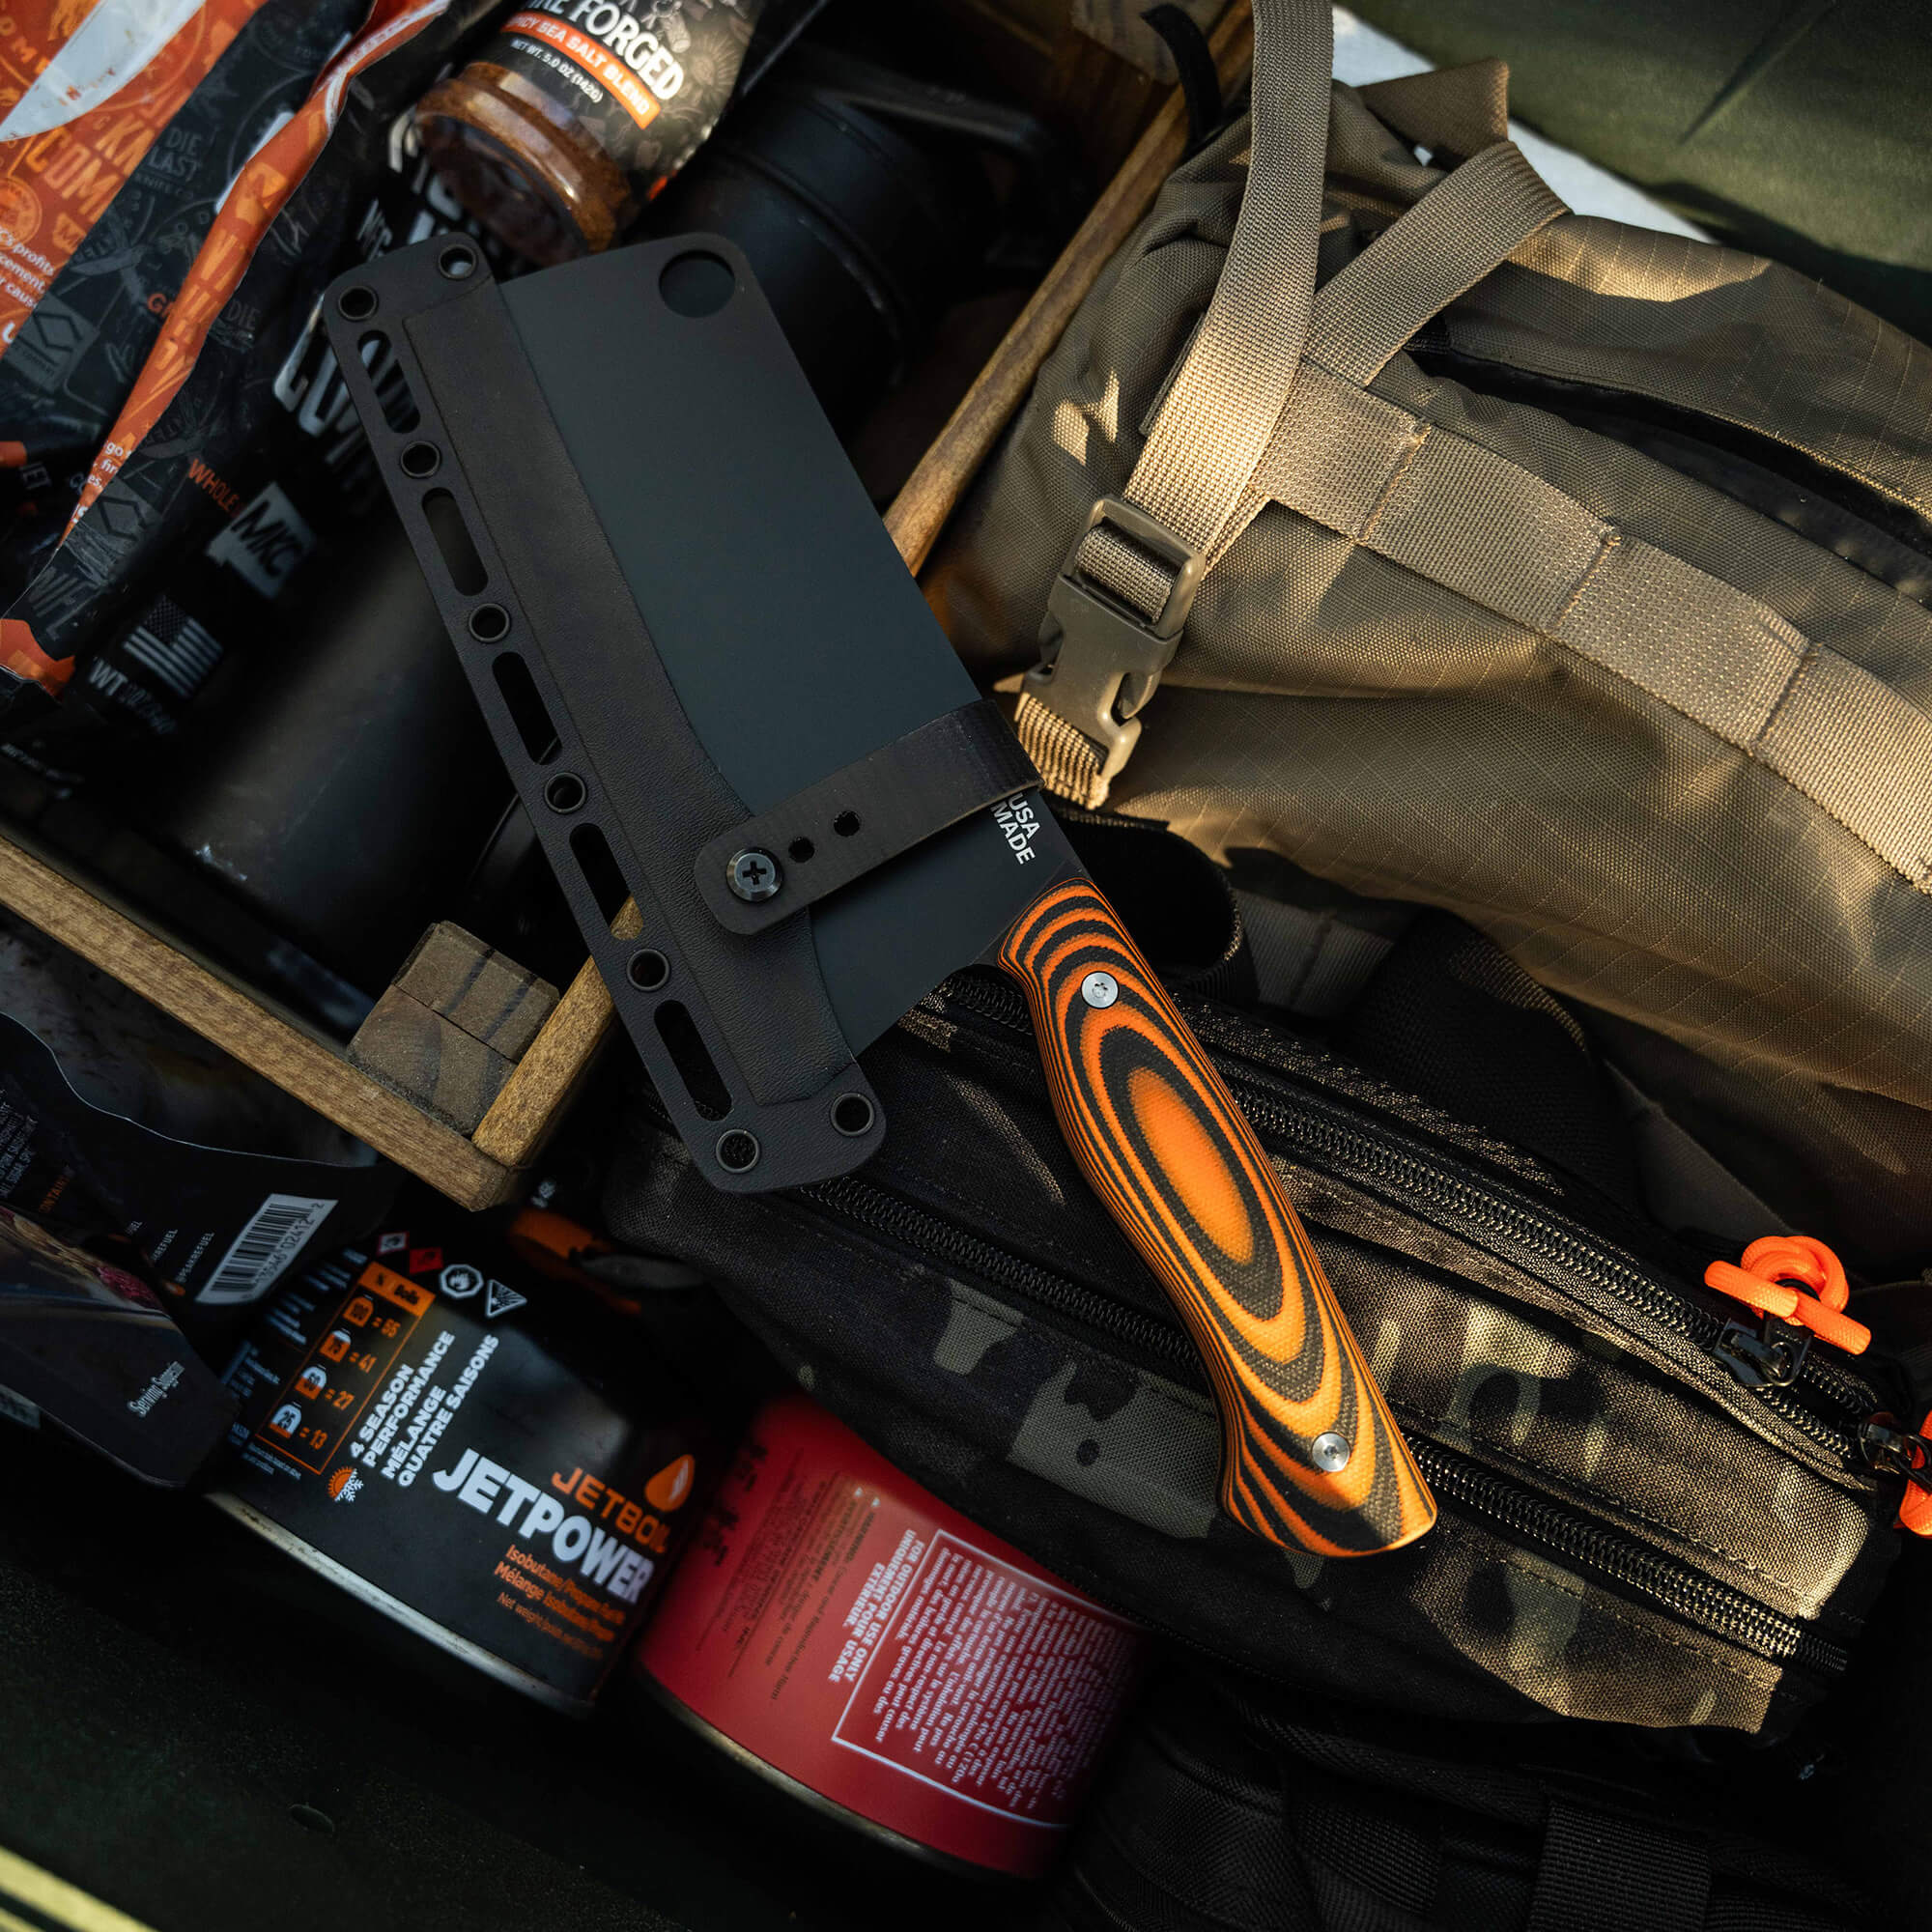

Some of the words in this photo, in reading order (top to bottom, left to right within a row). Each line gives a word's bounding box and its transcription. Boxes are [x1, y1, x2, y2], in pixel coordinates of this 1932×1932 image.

[542, 52, 560, 69] 5.0
[559, 61, 574, 77] OZ
[569, 0, 684, 99] FORGED
[537, 21, 567, 42] SEA
[566, 36, 607, 68] SALT
[603, 64, 650, 115] BLEND
[188, 458, 241, 513] WHOLE
[1008, 792, 1040, 838] USA
[990, 801, 1036, 865] MADE
[332, 1389, 355, 1412] 27
[350, 1441, 364, 1459] 4
[359, 1364, 414, 1442] SEASON
[364, 1330, 455, 1468] PERFORMANCE
[398, 1406, 454, 1488] QUATRE
[445, 1334, 499, 1410] SAISONS
[307, 1428, 329, 1451] 13
[382, 1384, 447, 1480] MÉLANGE
[433, 1448, 655, 1605] JETPOWER
[873, 1530, 914, 1601] UNIQUEMENT
[907, 1540, 923, 1561] FOR
[495, 1561, 545, 1601] Mélange
[875, 1564, 911, 1619] OUTDOOR
[852, 1603, 876, 1636] POUR
[862, 1622, 881, 1645] USE
[927, 1626, 937, 1636] et
[829, 1640, 857, 1681] USAGE
[890, 1645, 911, 1678] graves
[903, 1637, 932, 1682] directives
[933, 1640, 946, 1652] Le
[944, 1634, 962, 1660] effets
[844, 1647, 867, 1681] ONLY
[936, 1662, 947, 1677] sur
[883, 1680, 894, 1693] ou
[892, 1683, 907, 1707] peut
[905, 1654, 937, 1710] non-respect
[930, 1678, 942, 1688] le
[873, 1695, 888, 1713] des
[895, 1711, 910, 1728] des
[909, 1690, 933, 1729] système
[940, 1712, 953, 1726] Ne
[875, 1709, 895, 1742] causer
[913, 1727, 928, 1751] peut
[929, 1727, 943, 1746] pas
[943, 1701, 970, 1747] cartouche
[934, 1750, 945, 1764] au
